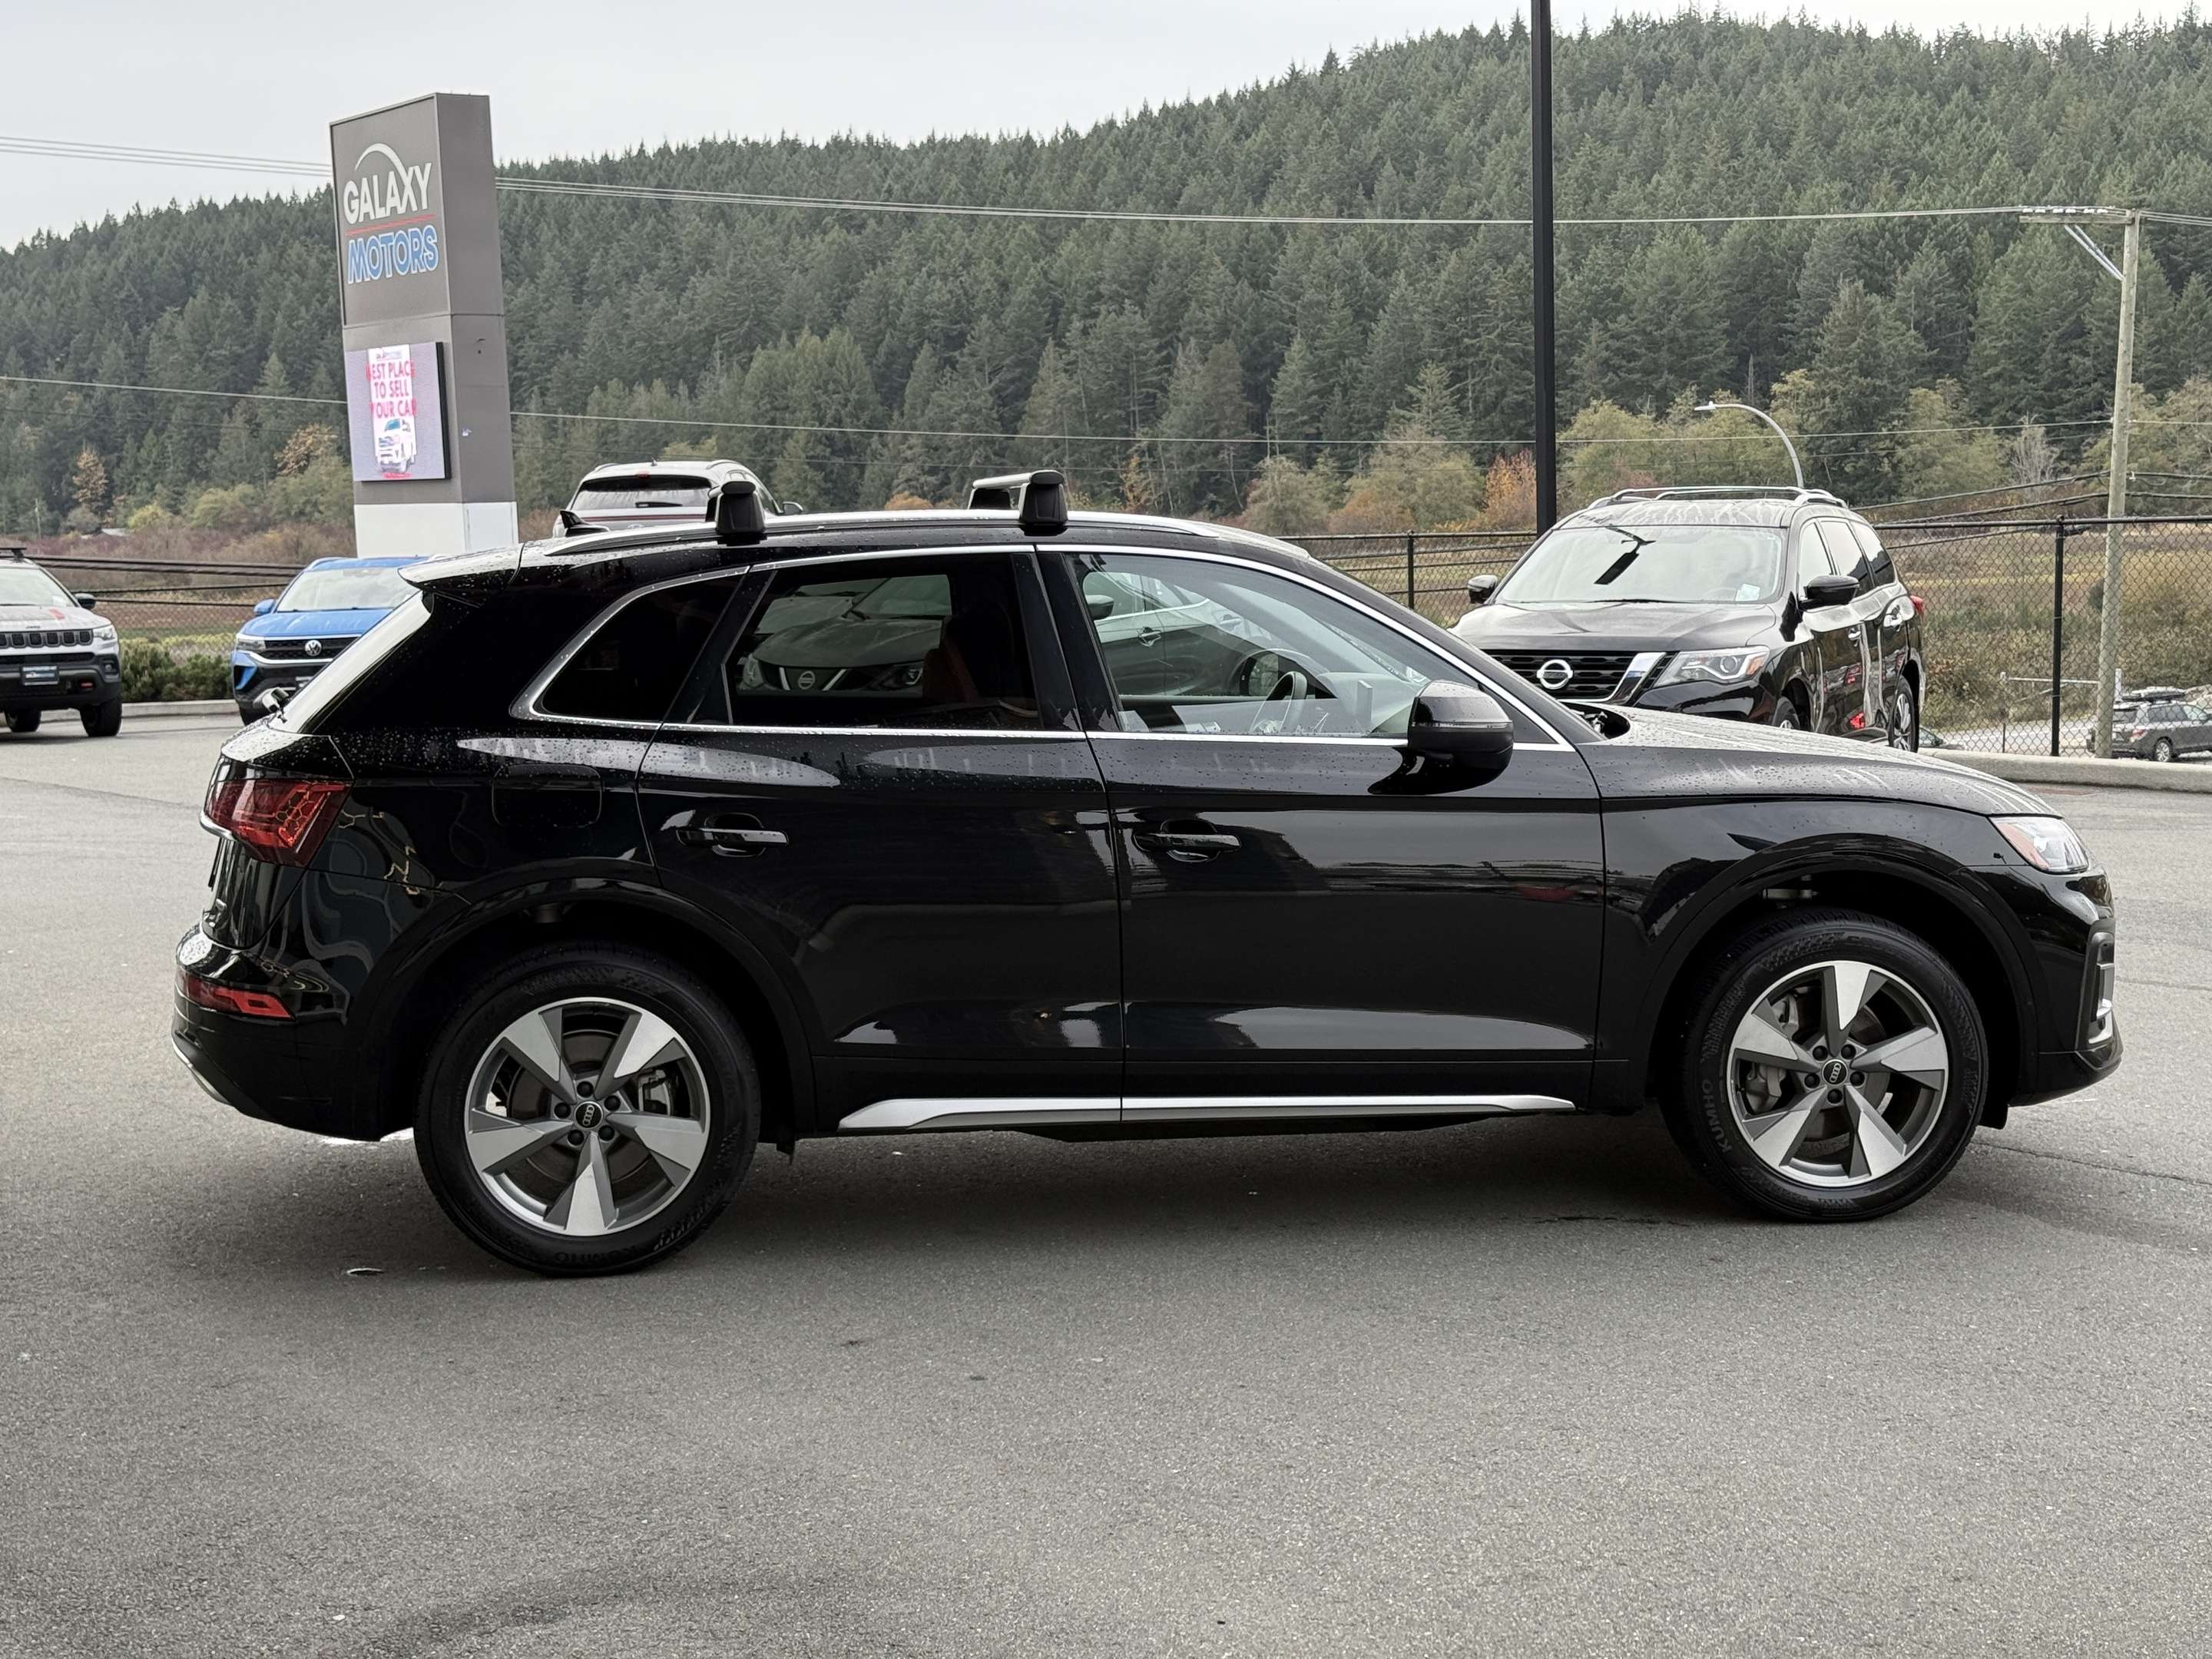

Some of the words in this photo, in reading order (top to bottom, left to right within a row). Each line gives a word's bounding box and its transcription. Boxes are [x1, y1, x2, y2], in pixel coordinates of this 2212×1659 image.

[343, 161, 432, 224] GALAXY
[348, 225, 439, 284] MOTORS
[369, 400, 395, 419] YOUR
[374, 381, 386, 399] TO
[389, 379, 409, 397] SELL
[1701, 1079, 1733, 1153] KUMHO
